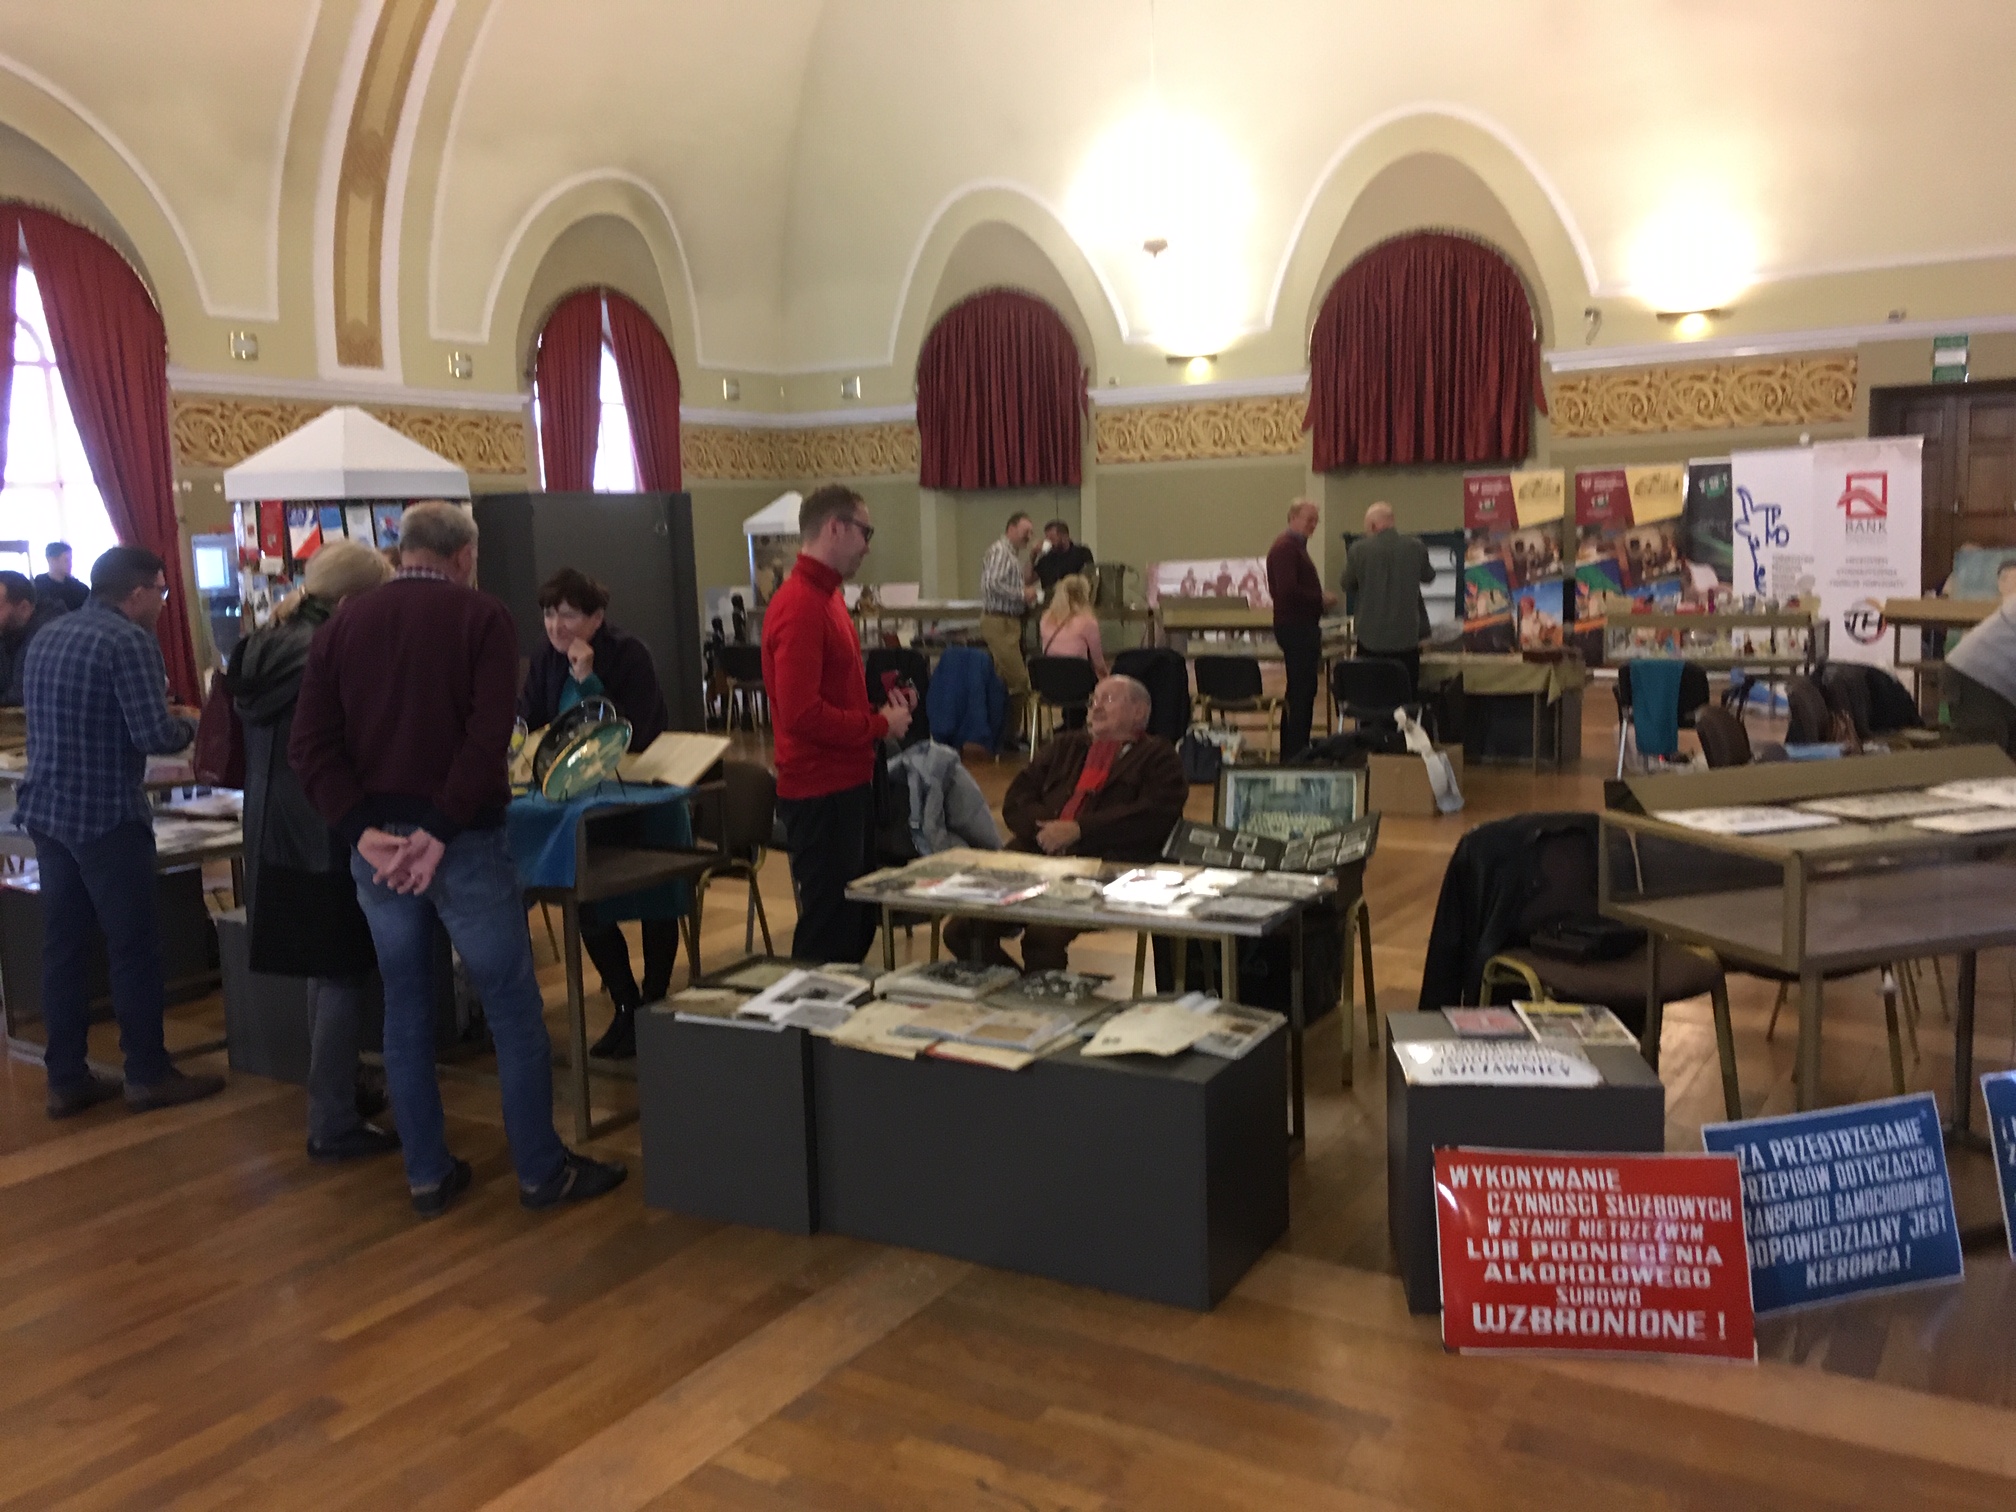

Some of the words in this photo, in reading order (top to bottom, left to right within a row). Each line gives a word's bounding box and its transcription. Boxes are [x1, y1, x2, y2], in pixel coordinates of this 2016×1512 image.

[1733, 1142, 1766, 1173] ZA
[1768, 1116, 1925, 1169] PRZESTRZEGANIE
[1449, 1164, 1621, 1193] WYKONYWANIE
[1745, 1195, 1832, 1238] RANSPORTU
[1834, 1173, 1946, 1222] SAMOCHODOWEGO
[1487, 1217, 1502, 1237] W
[1509, 1217, 1571, 1239] STANIE
[1908, 1205, 1948, 1240] JEST
[1466, 1237, 1519, 1261] LUB
[1531, 1240, 1724, 1267] PODNIECENIA
[1483, 1261, 1712, 1289] ALKOHOLOWEGO
[1805, 1247, 1901, 1290] KIEROWCA
[1555, 1285, 1642, 1308] SUROWO
[1472, 1302, 1708, 1341] WZBRONIONE
